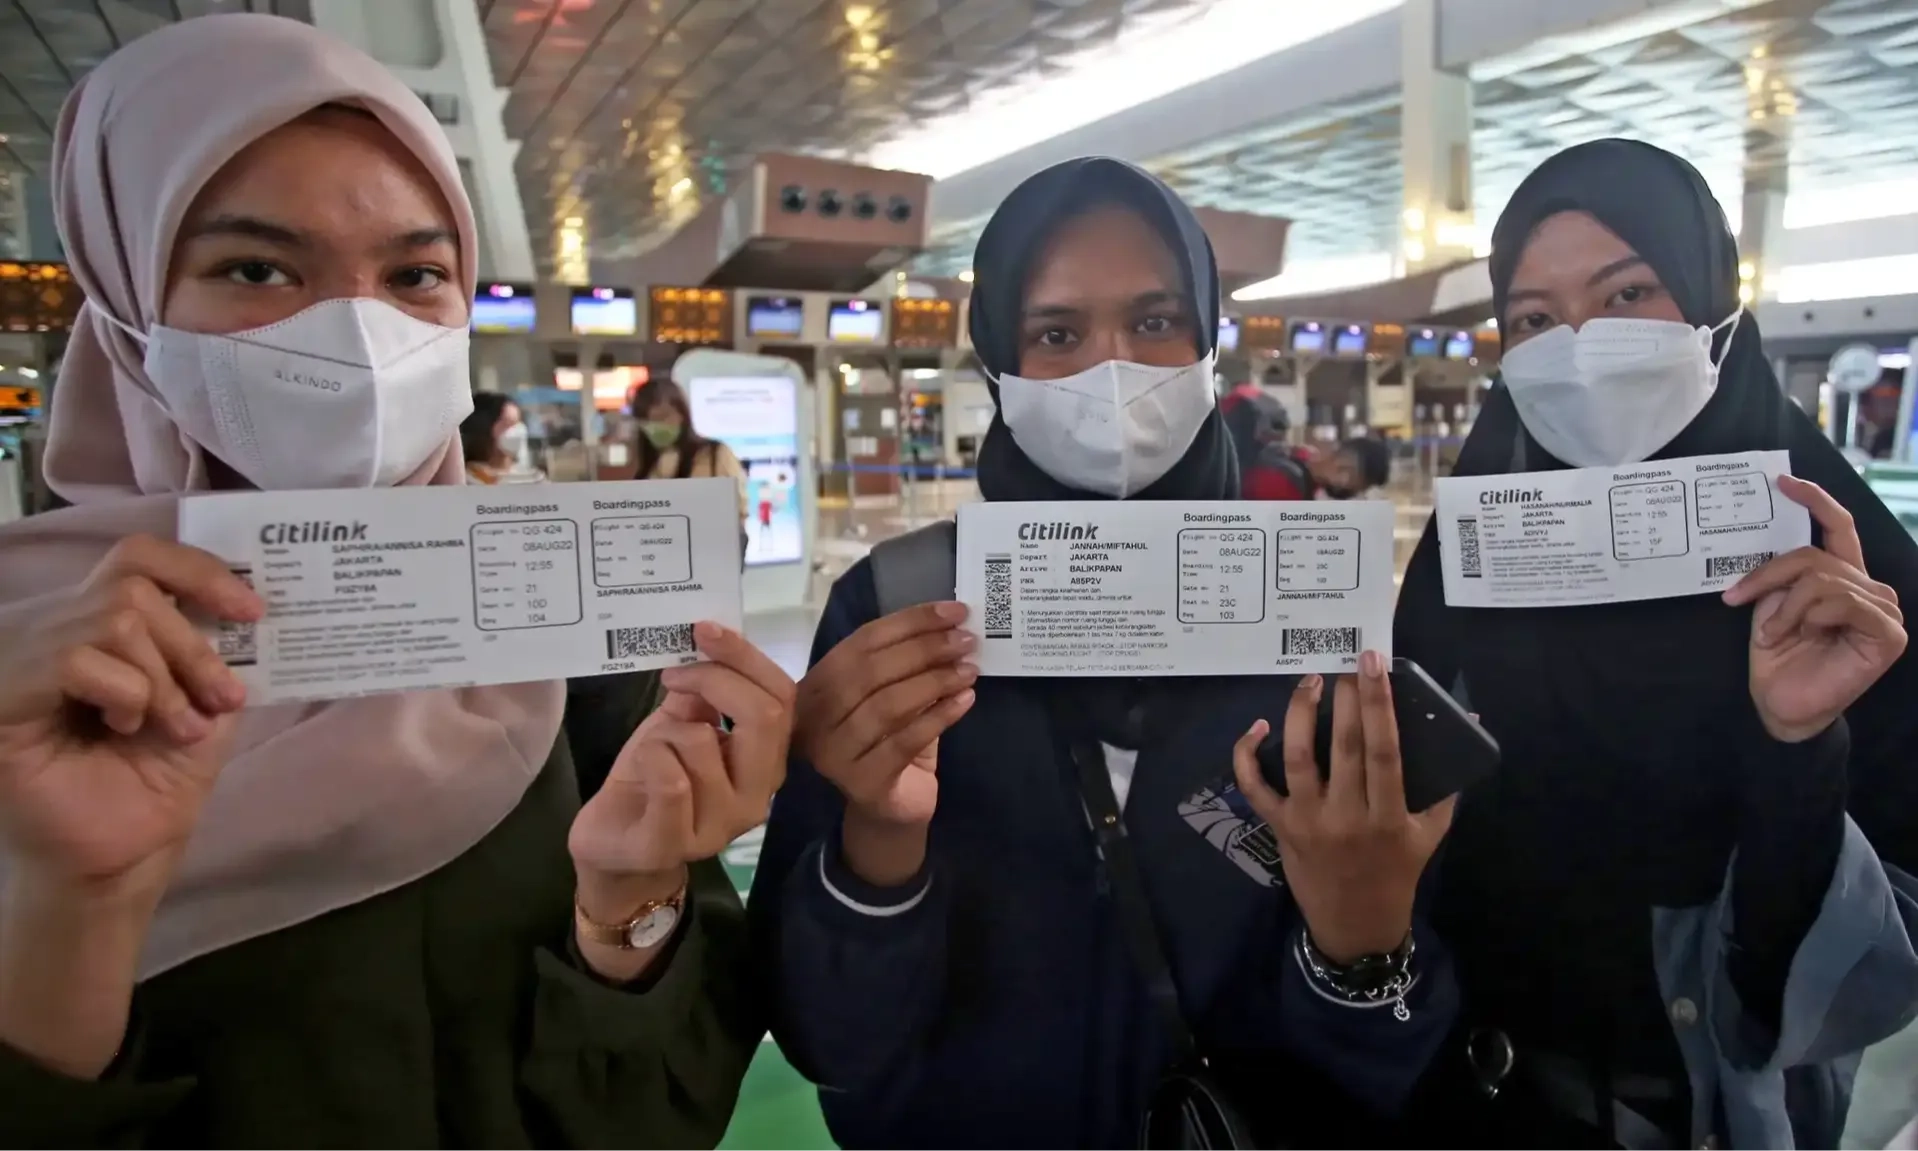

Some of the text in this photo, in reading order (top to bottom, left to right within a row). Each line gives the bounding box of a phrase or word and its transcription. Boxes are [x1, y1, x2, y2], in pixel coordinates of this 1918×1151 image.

[1696, 462, 1750, 472] Boardingpass
[1613, 470, 1672, 481] Boardingpass
[1645, 486, 1658, 494] QG
[1479, 488, 1543, 505] Citilink
[476, 504, 559, 515] Boardingpass
[593, 500, 671, 510] Boardingpass
[1183, 513, 1252, 524] Boardingpass
[1280, 512, 1346, 522] Boardingpass
[1522, 519, 1565, 528] BALIKPAPAN
[260, 520, 368, 545] Citilink
[522, 526, 541, 535] QG
[543, 525, 562, 534] 424
[1018, 522, 1099, 541] Citilink
[1648, 527, 1656, 535] 21
[1219, 533, 1235, 542] QG
[1237, 533, 1253, 541] 424
[523, 540, 573, 552] 08AUG22
[1069, 542, 1148, 550] JANNAH/MIFTAHUL
[1219, 548, 1261, 556] 08AUG22
[333, 556, 383, 566] JAKARTA
[1020, 553, 1109, 562] Depart JAKARTA
[526, 560, 553, 571] 12:55
[1069, 565, 1123, 573] BALIKPAPAN
[1219, 565, 1244, 574] 12:55
[333, 569, 402, 580] BALIKPAPAN
[525, 584, 537, 594] 21
[671, 583, 703, 593] RAHMA
[1219, 585, 1230, 593] 21
[1277, 592, 1345, 600] JANNAH/MIFTAHUL
[528, 599, 547, 609] 10D
[1219, 599, 1236, 607] 23C
[528, 614, 546, 623] 104
